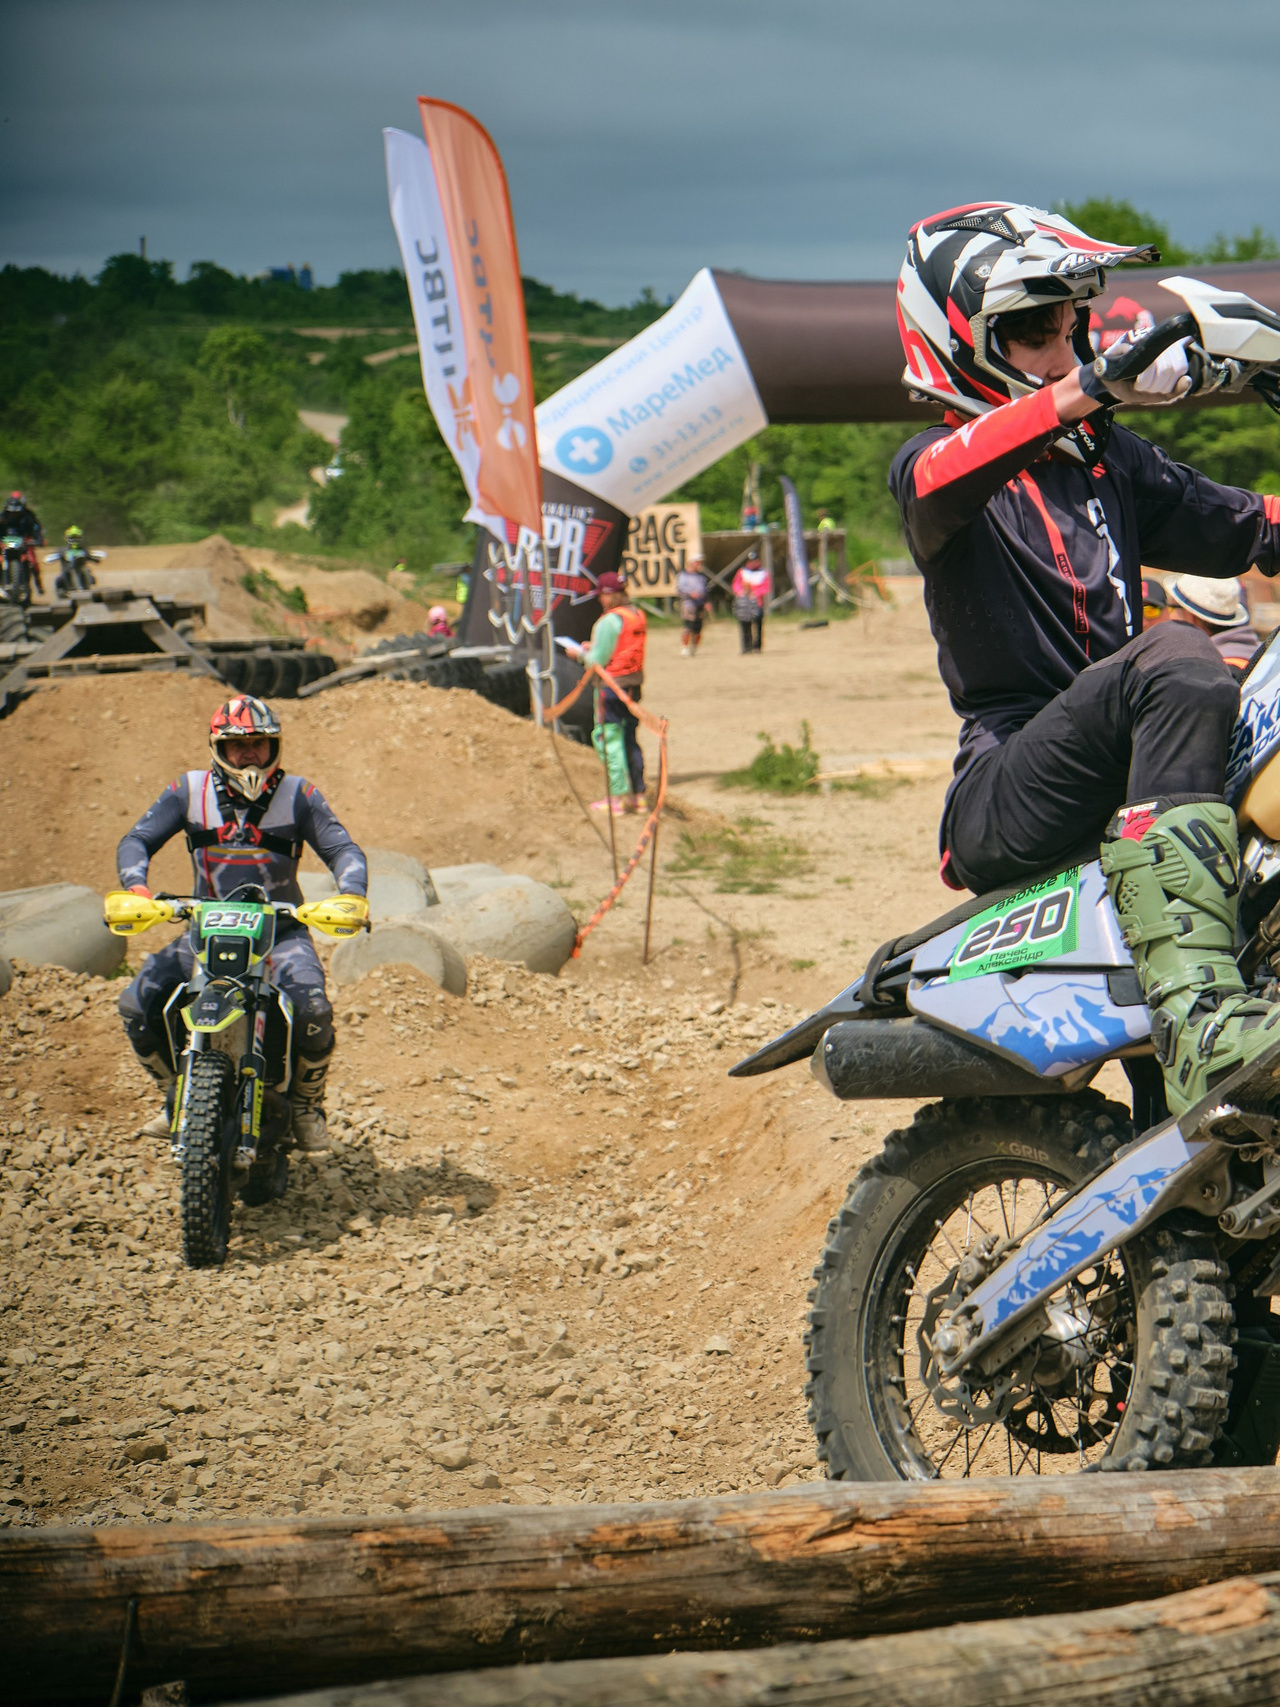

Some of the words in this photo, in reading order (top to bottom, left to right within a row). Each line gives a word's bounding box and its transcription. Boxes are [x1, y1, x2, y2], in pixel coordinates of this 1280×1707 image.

[606, 346, 734, 437] МареМед
[652, 405, 724, 459] 31-13-13
[623, 549, 686, 588] RUN
[204, 910, 262, 930] 234
[955, 888, 1073, 966] 250
[976, 950, 1044, 973] Александр
[989, 947, 1029, 962] Пачес
